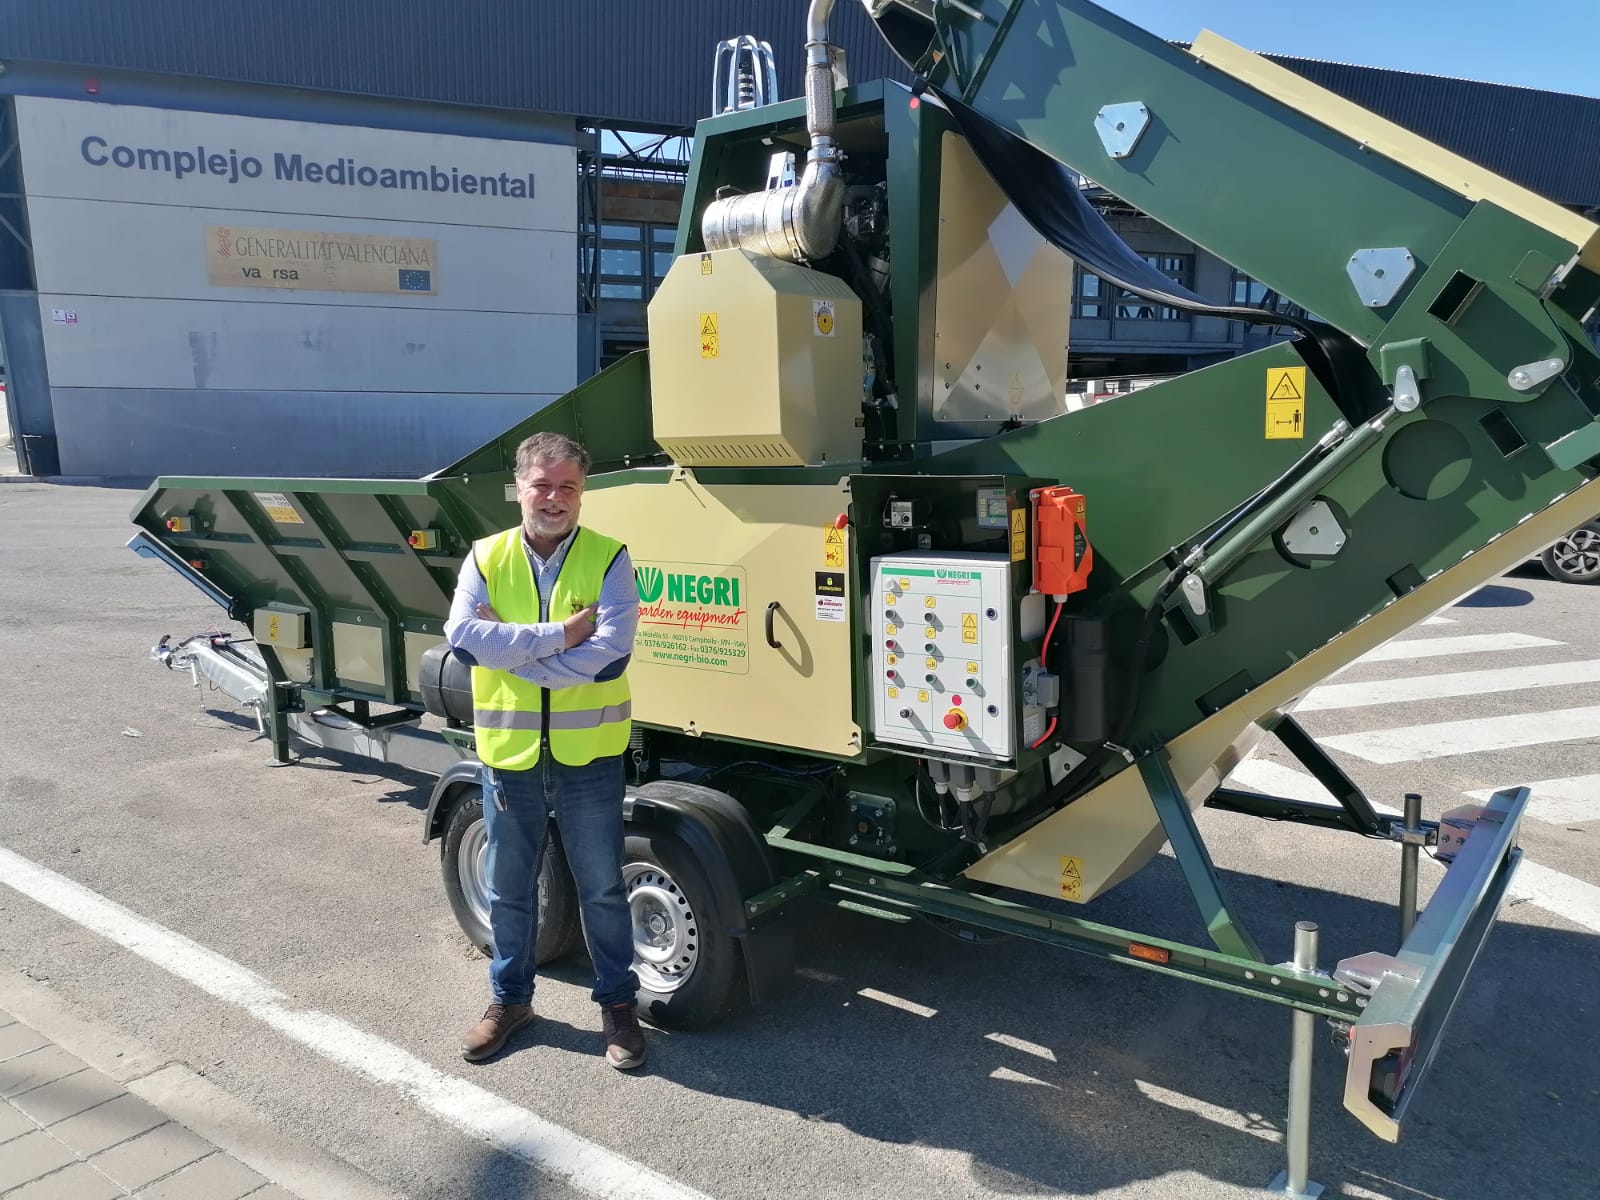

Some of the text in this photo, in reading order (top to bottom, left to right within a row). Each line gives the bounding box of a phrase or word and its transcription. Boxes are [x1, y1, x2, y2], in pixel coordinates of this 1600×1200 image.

[81, 136, 535, 199] Complejo Medioambiental
[235, 236, 431, 267] GENERALITAT VALENCIANA
[667, 573, 740, 607] NEGRI
[676, 606, 747, 631] equipment
[652, 651, 728, 667] www.negri-bio.com
